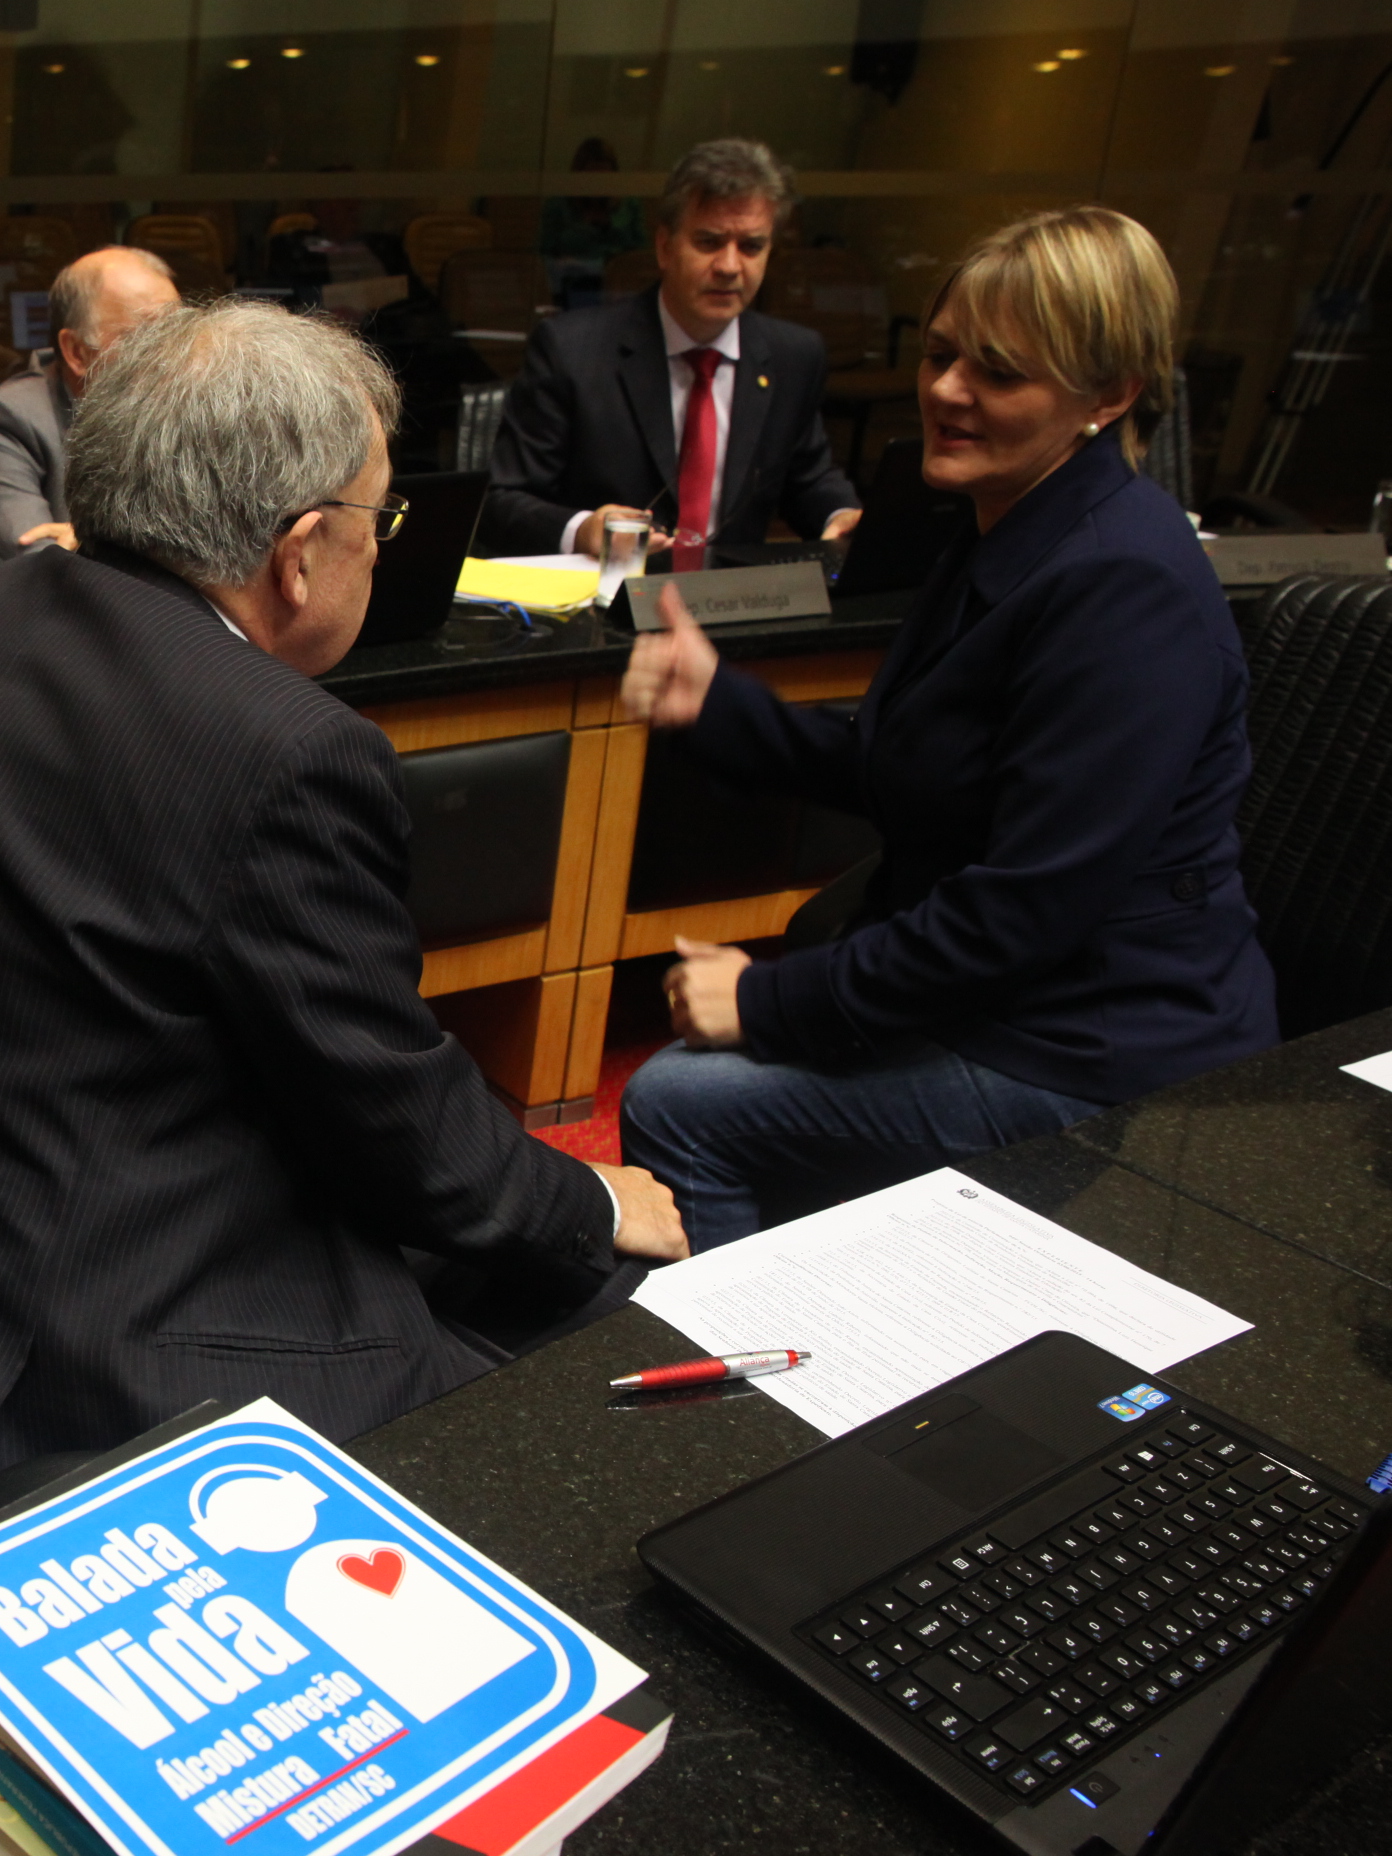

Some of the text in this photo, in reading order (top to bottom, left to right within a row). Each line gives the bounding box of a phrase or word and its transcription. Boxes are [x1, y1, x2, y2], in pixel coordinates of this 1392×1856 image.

[706, 598, 738, 613] Cesar
[739, 1356, 770, 1367] Aliança
[162, 1566, 228, 1610] pela
[42, 1594, 311, 1750] Vida
[156, 1671, 363, 1800] Álcool e Direção
[194, 1699, 404, 1838] Mistura Fatal
[285, 1763, 396, 1841] DETRAN/SC
